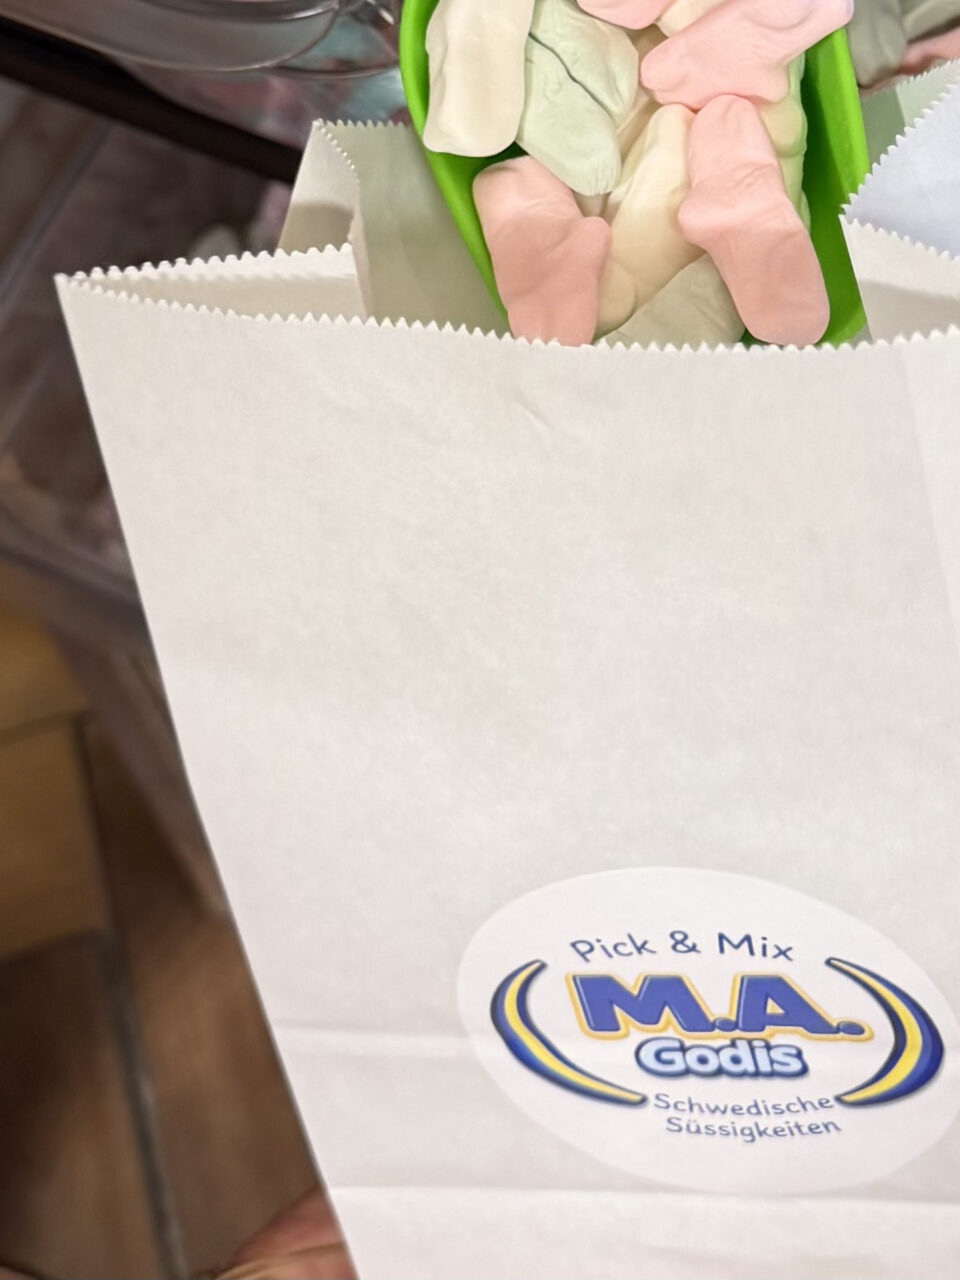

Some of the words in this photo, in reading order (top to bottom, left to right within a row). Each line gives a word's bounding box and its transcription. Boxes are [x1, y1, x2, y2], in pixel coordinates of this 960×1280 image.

[570, 933, 656, 963] Pick
[669, 930, 700, 955] &
[718, 932, 794, 961] Mix
[566, 972, 874, 1042] M.A.
[634, 1036, 810, 1080] Godis
[653, 1093, 835, 1117] Schwedische
[665, 1116, 842, 1143] Süssigkeiten
